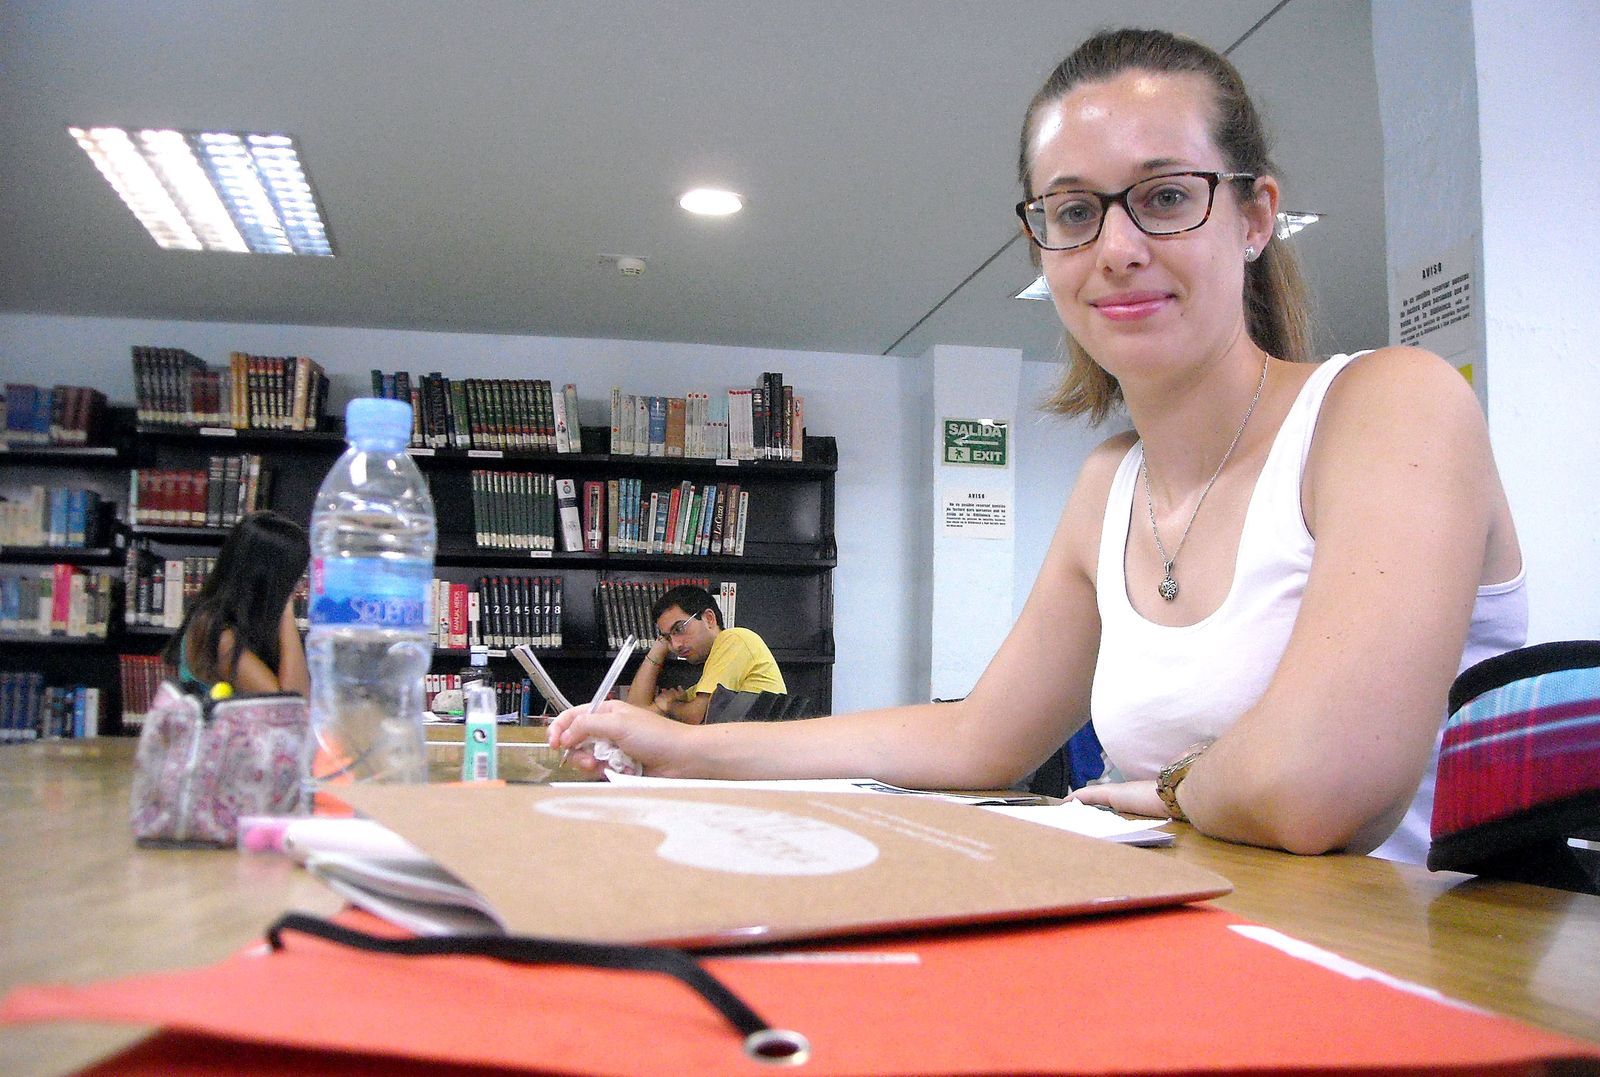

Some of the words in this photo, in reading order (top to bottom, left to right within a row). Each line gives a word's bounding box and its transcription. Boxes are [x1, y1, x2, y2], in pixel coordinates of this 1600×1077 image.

[1421, 262, 1442, 279] AVISO
[948, 423, 1002, 438] SALIDA
[973, 450, 1003, 462] EXIT
[484, 605, 489, 614] 1
[493, 605, 500, 614] 2
[504, 606, 510, 614] 3
[514, 606, 521, 615] 4
[524, 606, 530, 615] 5
[534, 605, 541, 614] 6
[544, 605, 551, 614] 7
[554, 605, 561, 614] 8
